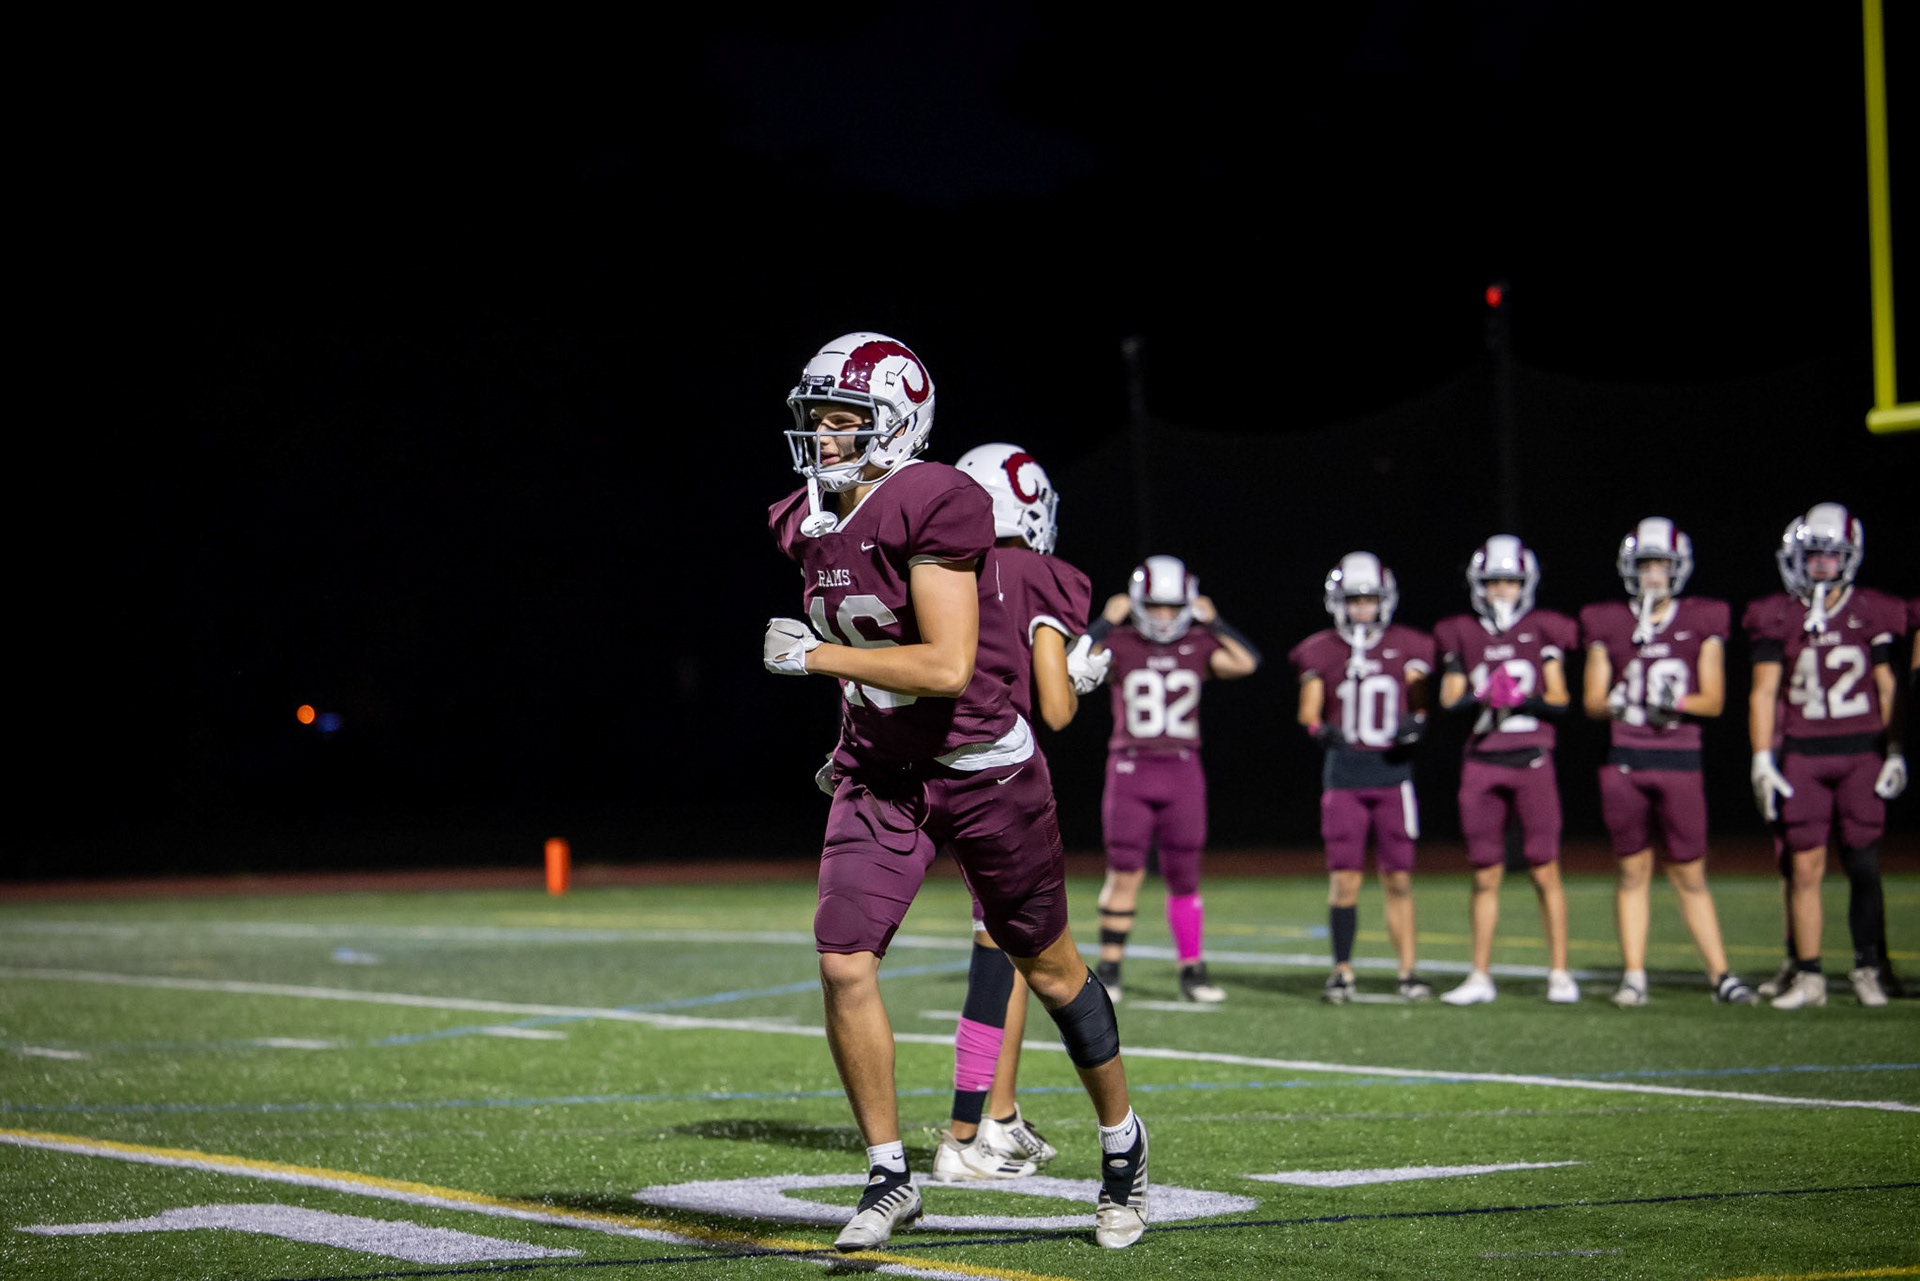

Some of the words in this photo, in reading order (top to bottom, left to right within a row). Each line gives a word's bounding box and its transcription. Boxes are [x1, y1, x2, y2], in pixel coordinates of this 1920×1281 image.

[817, 569, 851, 588] RAMS
[809, 594, 919, 710] 16
[1789, 645, 1870, 720] 42
[1123, 668, 1200, 739] 82
[1336, 675, 1400, 747] 10
